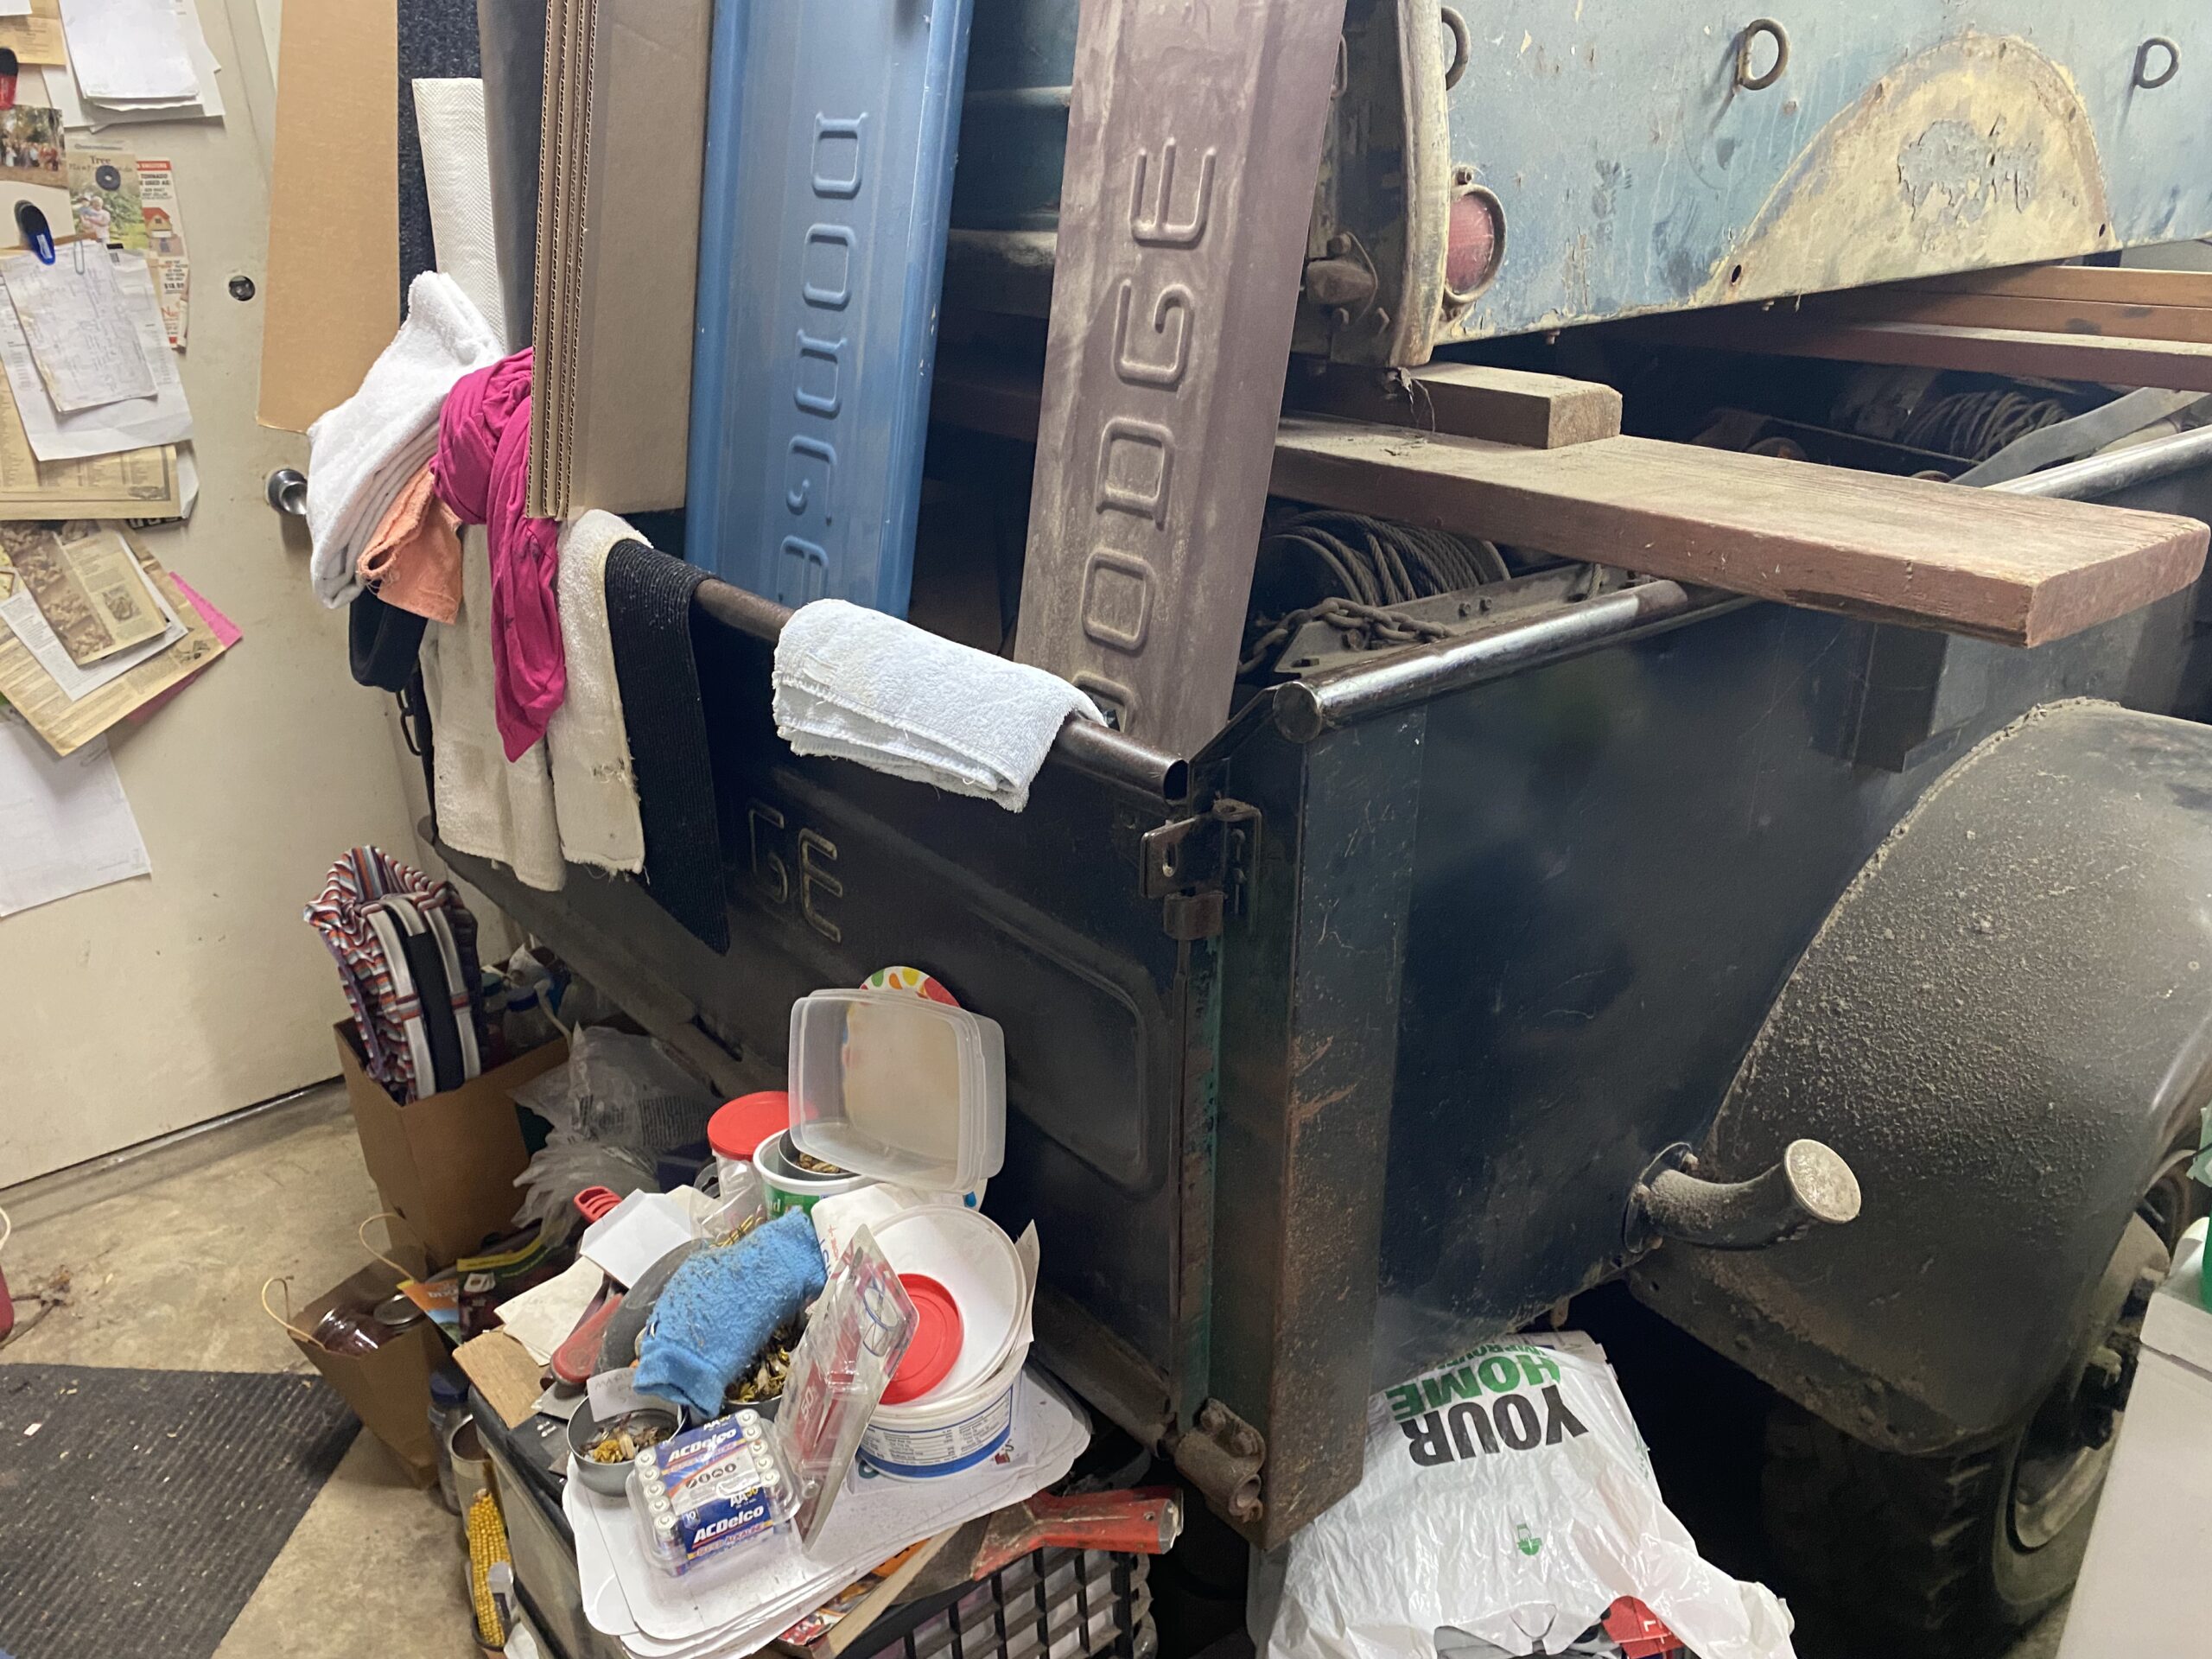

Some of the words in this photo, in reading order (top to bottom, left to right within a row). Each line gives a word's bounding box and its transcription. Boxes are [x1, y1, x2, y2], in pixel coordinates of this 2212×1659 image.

[1386, 1354, 1561, 1421] HOME
[669, 1428, 737, 1463] ACDelco
[1400, 1384, 1589, 1467] YOUR
[692, 1504, 764, 1544] ACDelco
